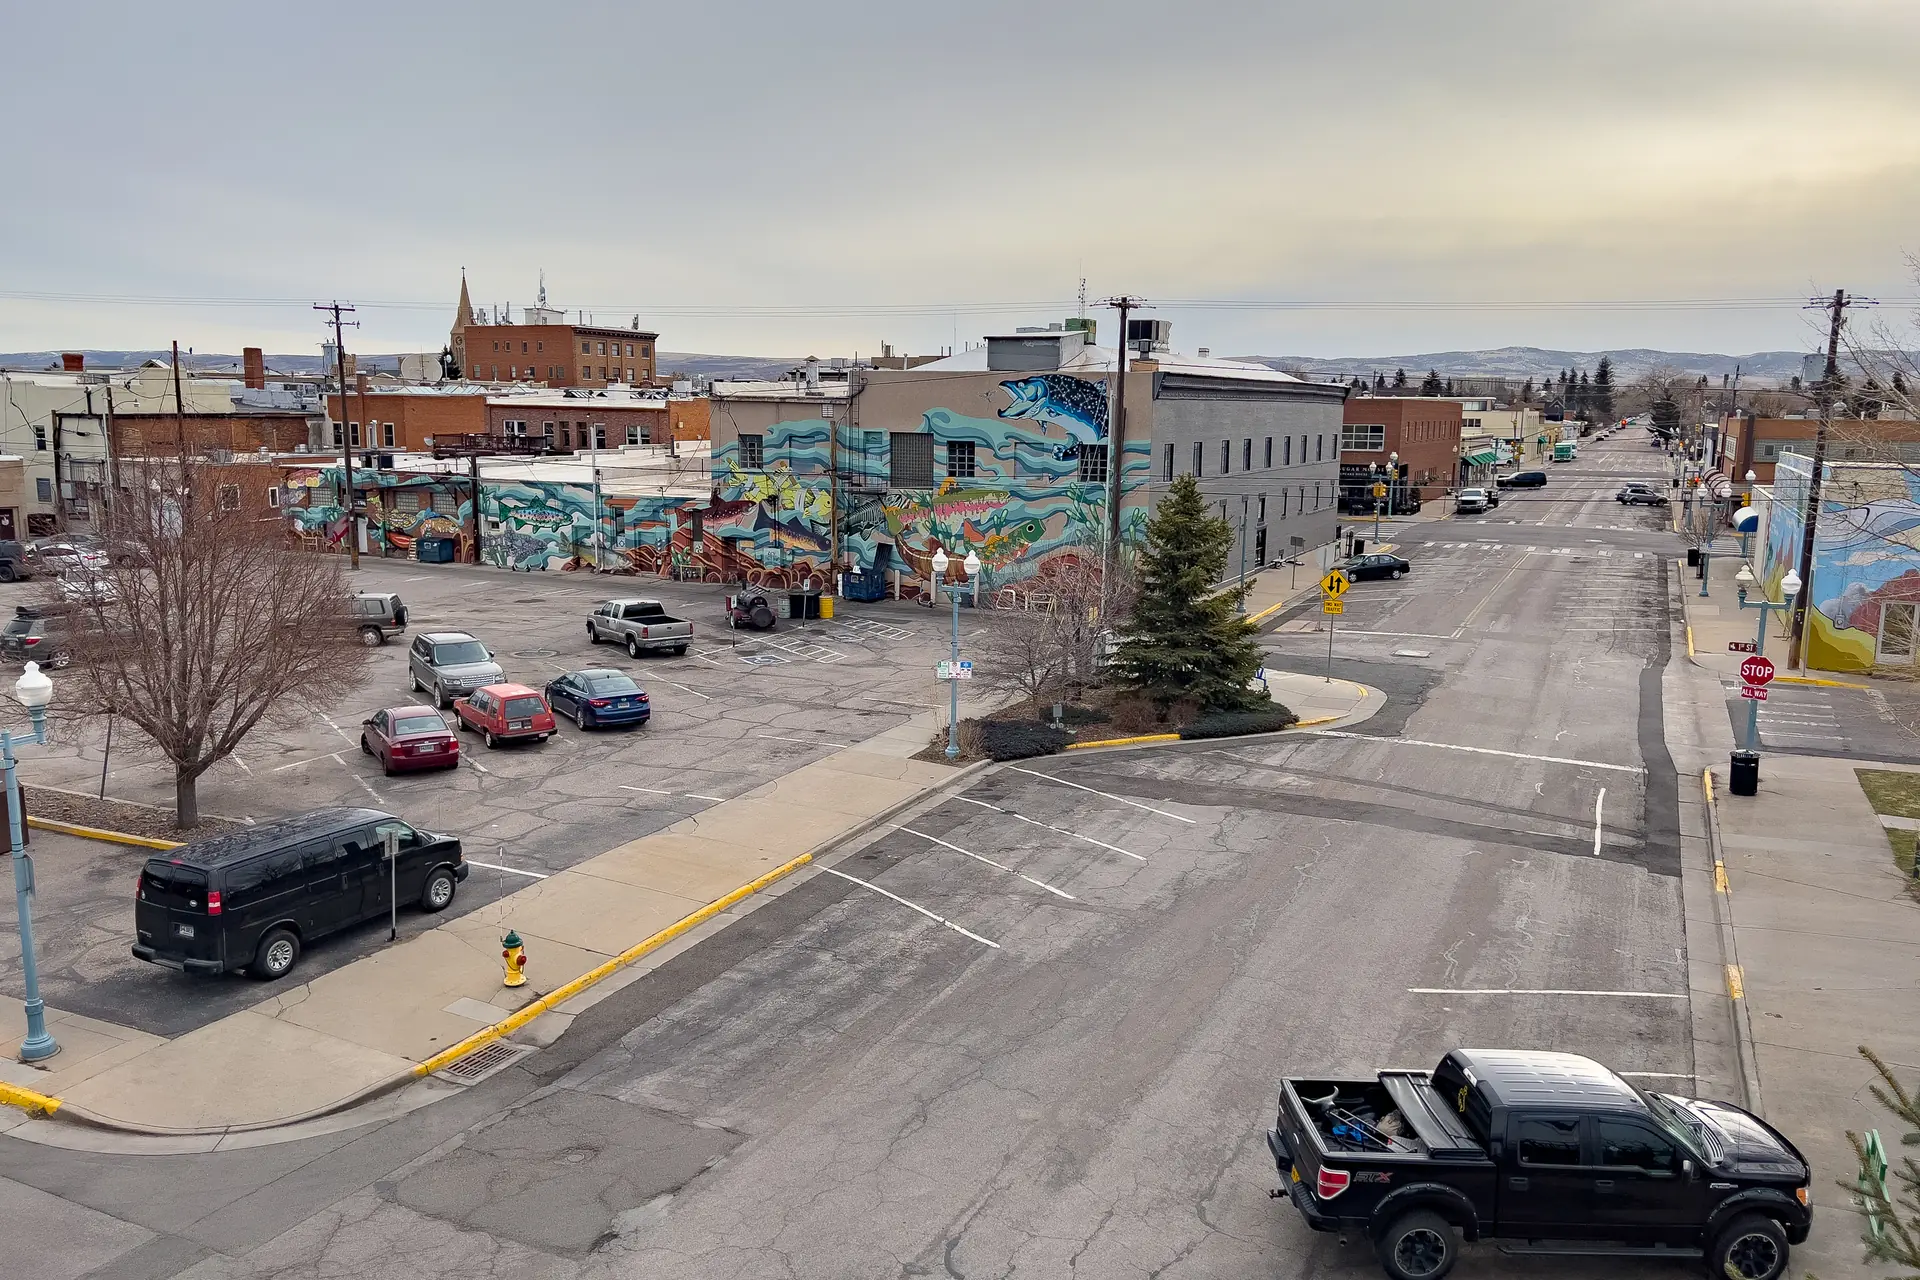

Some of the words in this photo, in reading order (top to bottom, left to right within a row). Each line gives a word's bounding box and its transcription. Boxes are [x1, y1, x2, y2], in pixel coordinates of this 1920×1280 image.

[1745, 644, 1754, 652] ST
[1741, 664, 1773, 678] STOP
[1741, 688, 1753, 697] ALL
[1753, 690, 1768, 699] WAY
